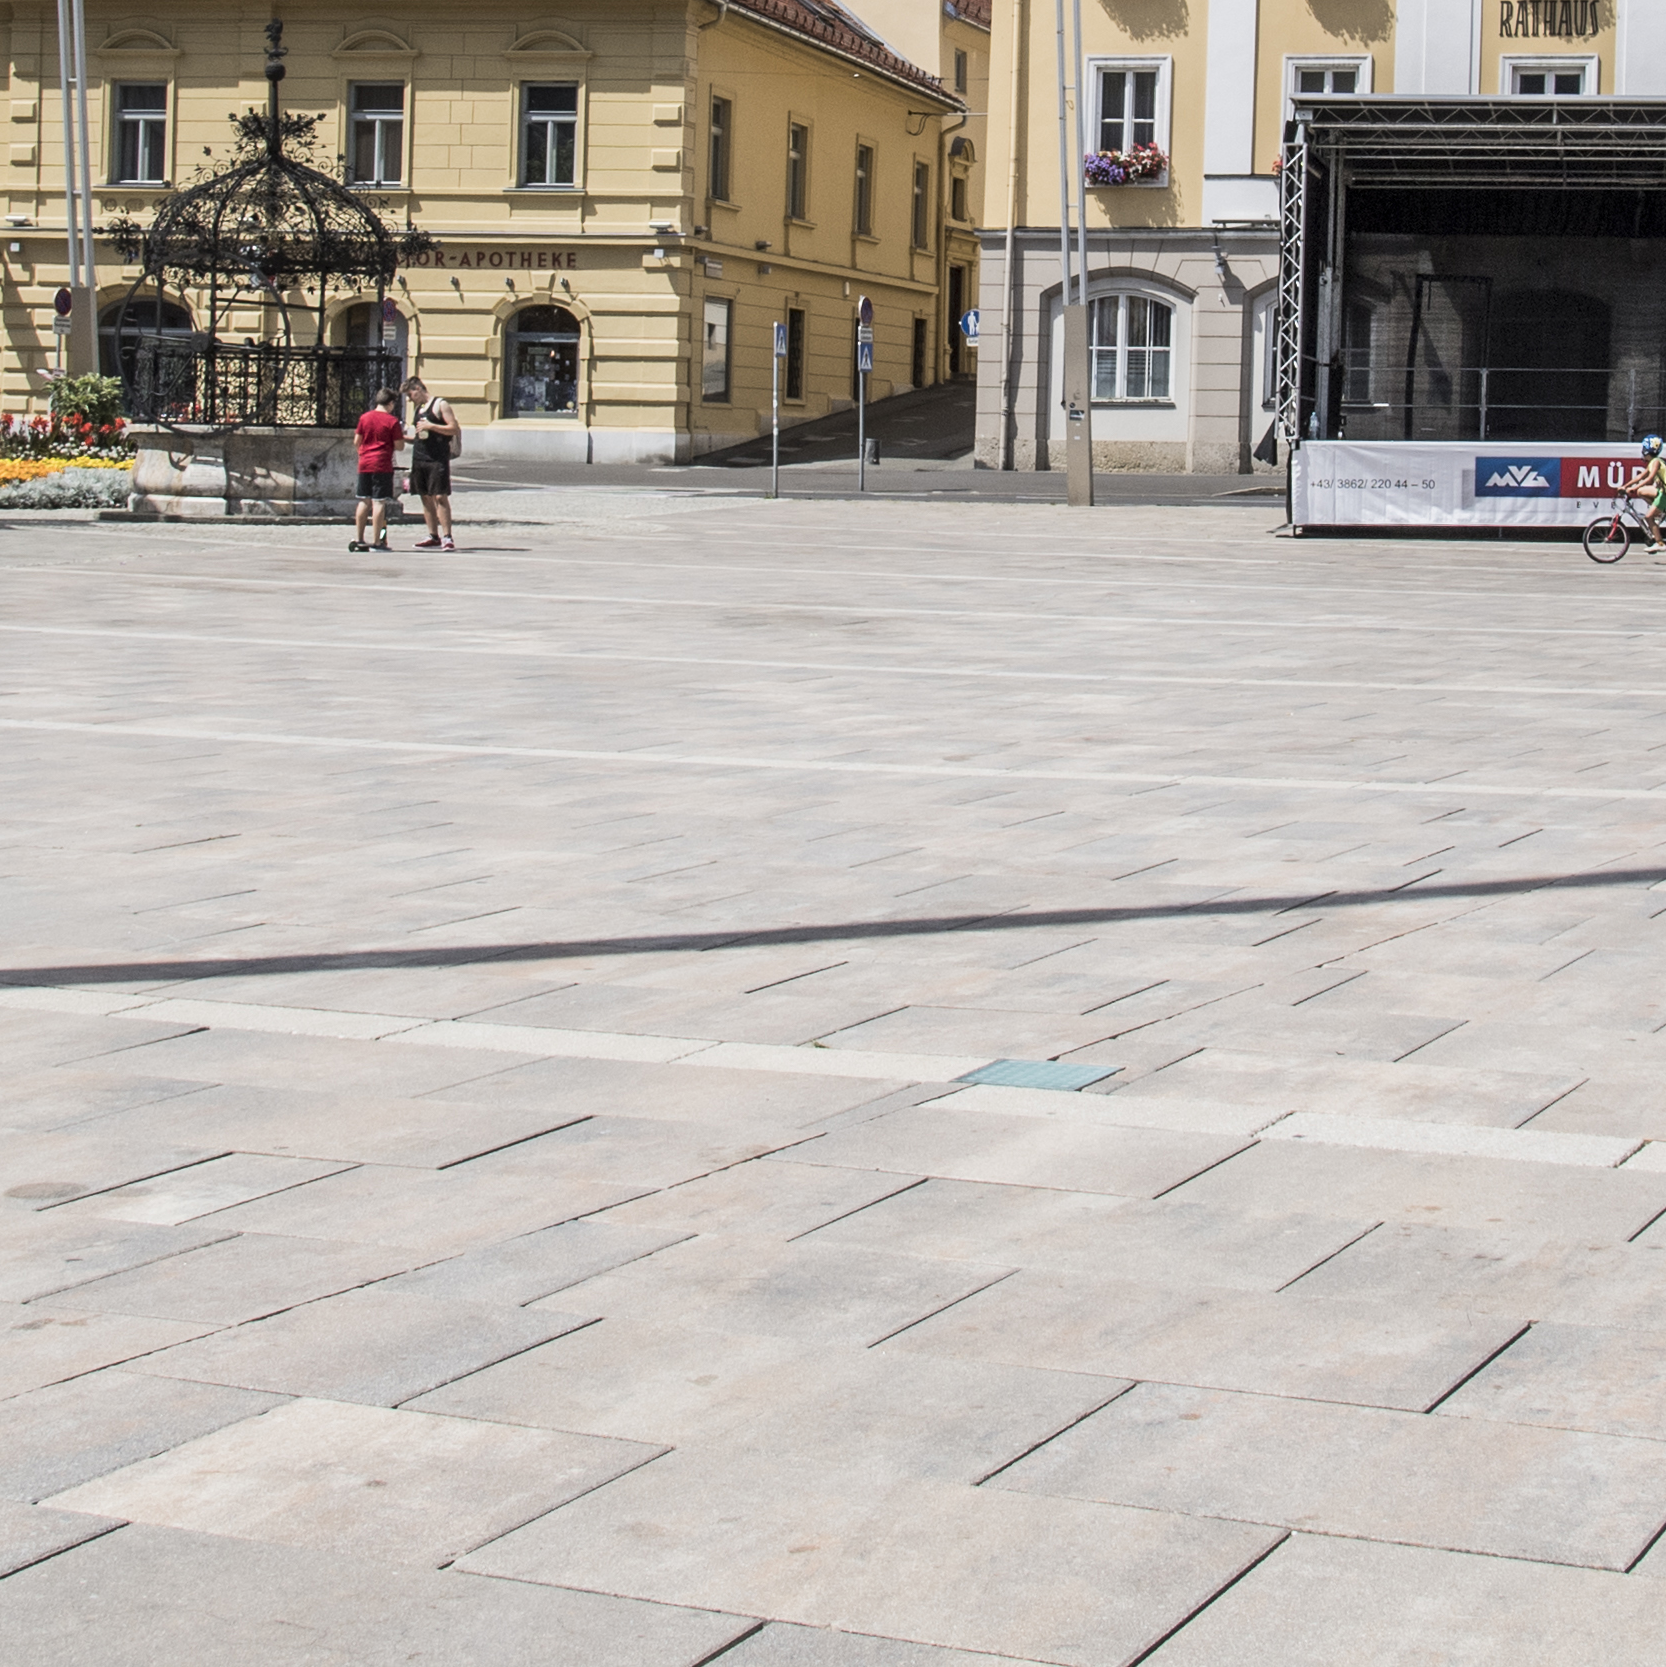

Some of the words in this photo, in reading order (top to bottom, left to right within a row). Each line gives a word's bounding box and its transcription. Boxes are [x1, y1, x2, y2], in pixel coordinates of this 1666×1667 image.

[1499, 0, 1600, 38] RATHAUS
[395, 251, 577, 269] TOR-APOTHEKE
[1310, 478, 1334, 490] +43/
[1337, 478, 1368, 490] 3862/
[1371, 478, 1392, 490] 220
[1394, 478, 1408, 490] 44
[1421, 478, 1436, 490] 50
[1484, 465, 1550, 487] MVG
